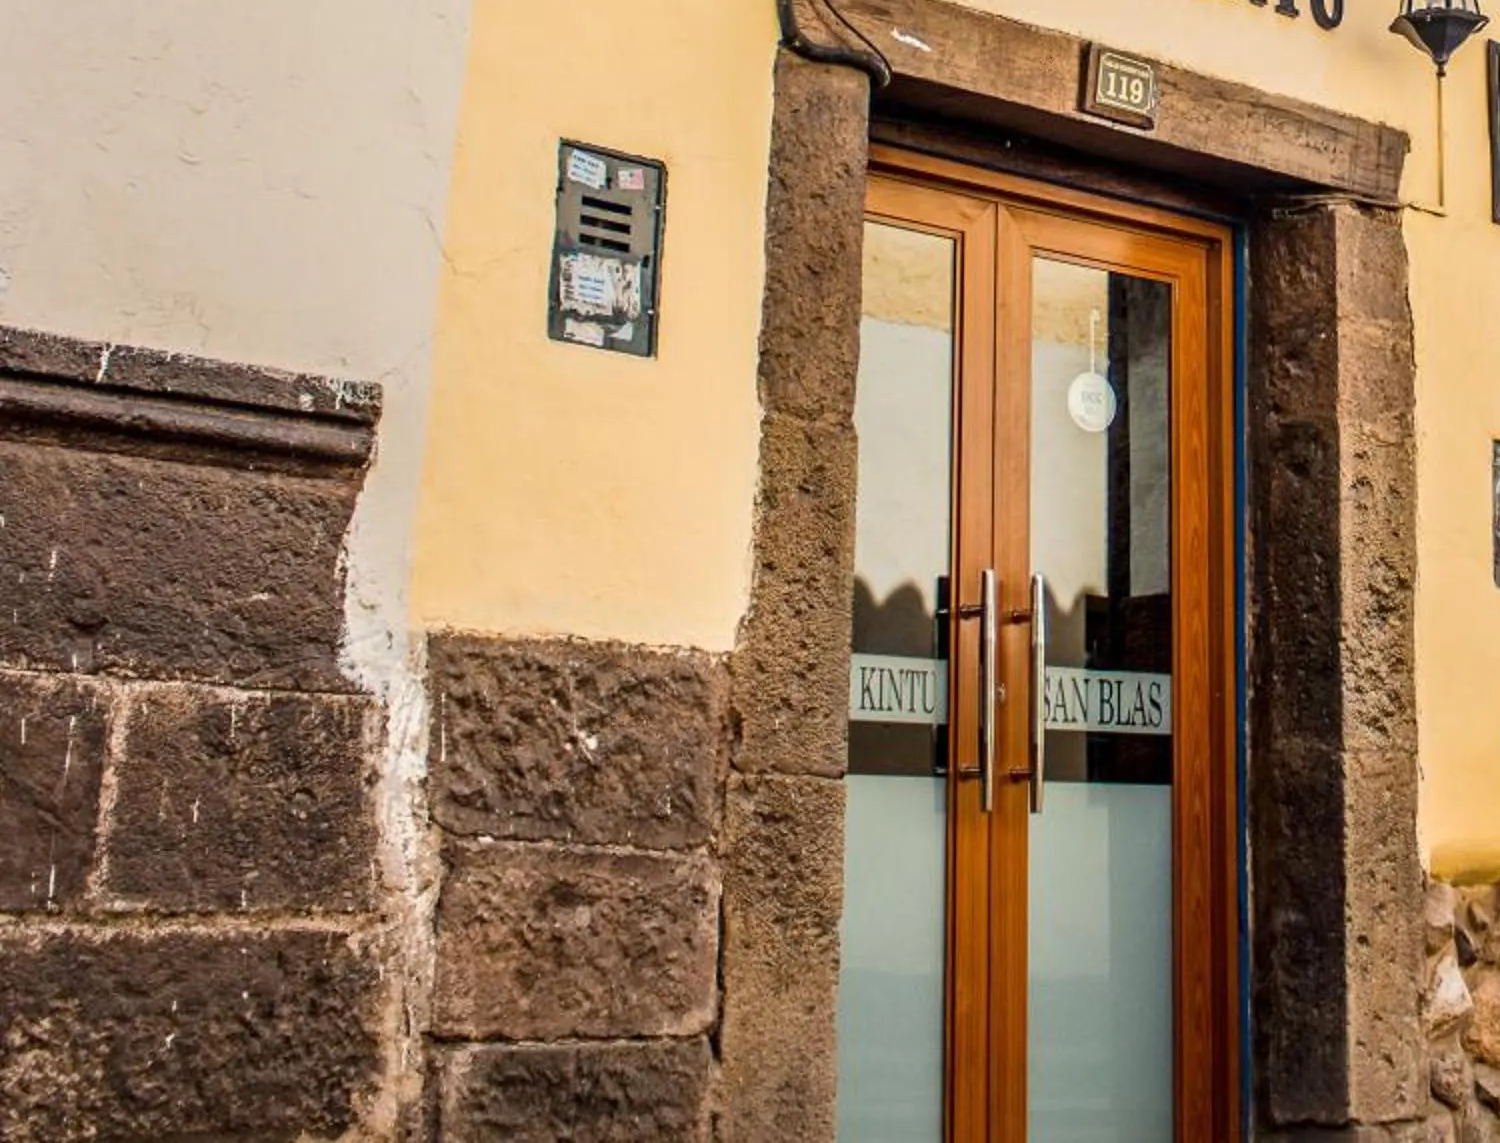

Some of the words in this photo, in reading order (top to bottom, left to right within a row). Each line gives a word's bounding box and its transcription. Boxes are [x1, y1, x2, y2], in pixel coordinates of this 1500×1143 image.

[1105, 72, 1143, 104] 119
[860, 666, 936, 714] KINTU
[1098, 678, 1162, 727] BLAS
